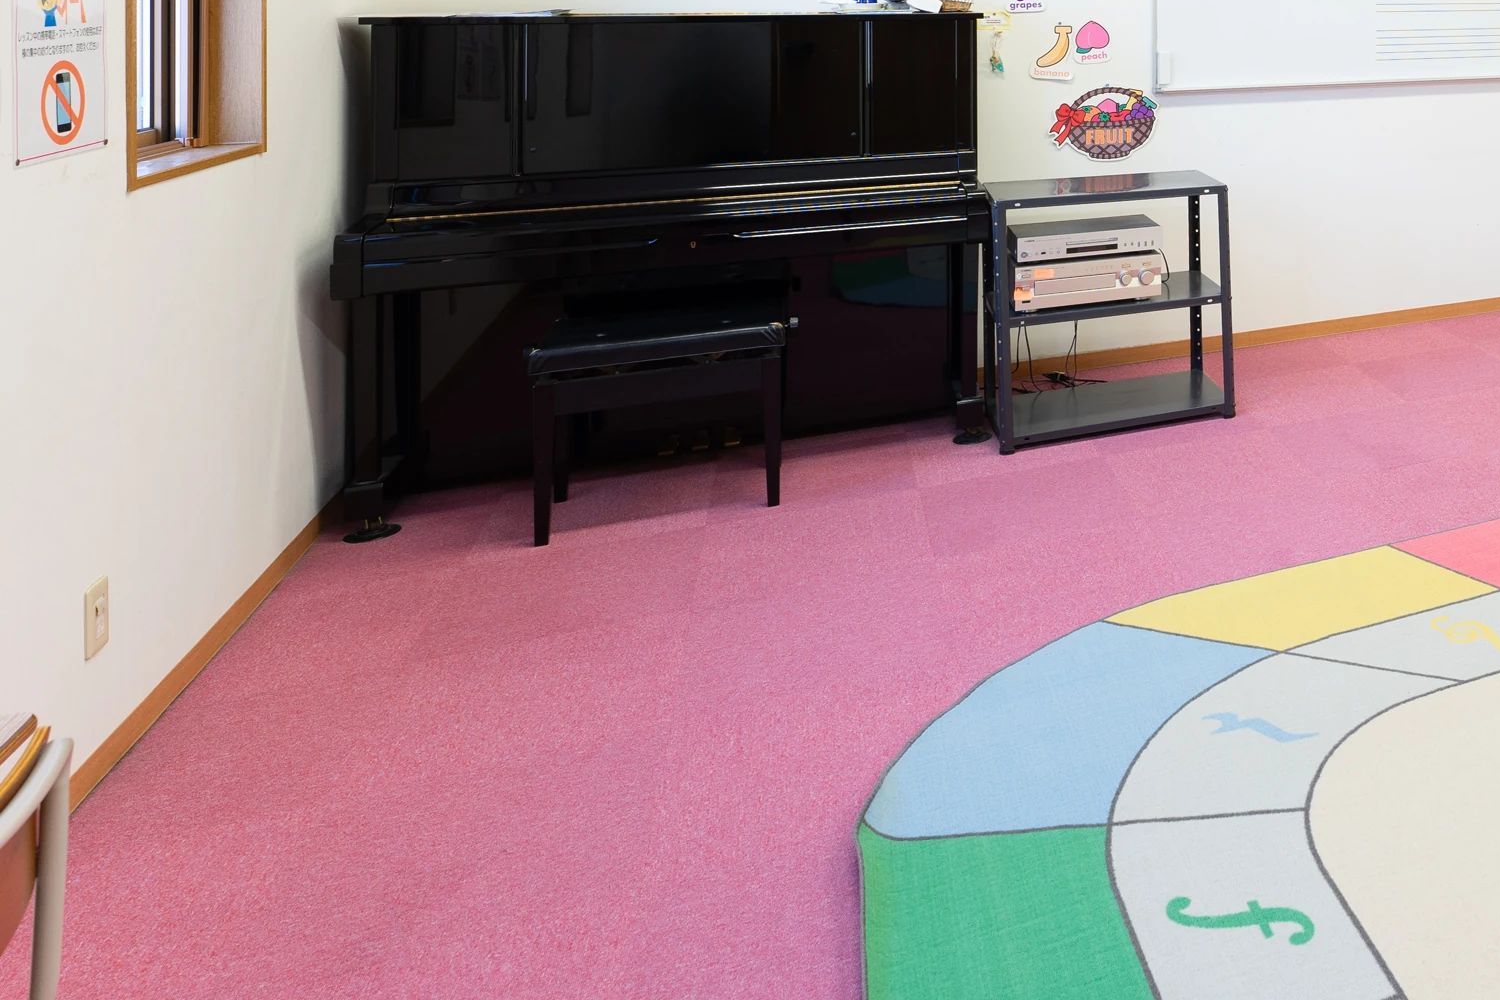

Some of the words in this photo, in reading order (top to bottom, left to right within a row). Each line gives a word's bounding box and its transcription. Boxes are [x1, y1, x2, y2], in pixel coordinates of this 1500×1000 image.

[1010, 1, 1042, 10] grapes
[1081, 52, 1107, 62] peach
[1034, 68, 1070, 78] banana
[1085, 127, 1134, 145] FRUIT
